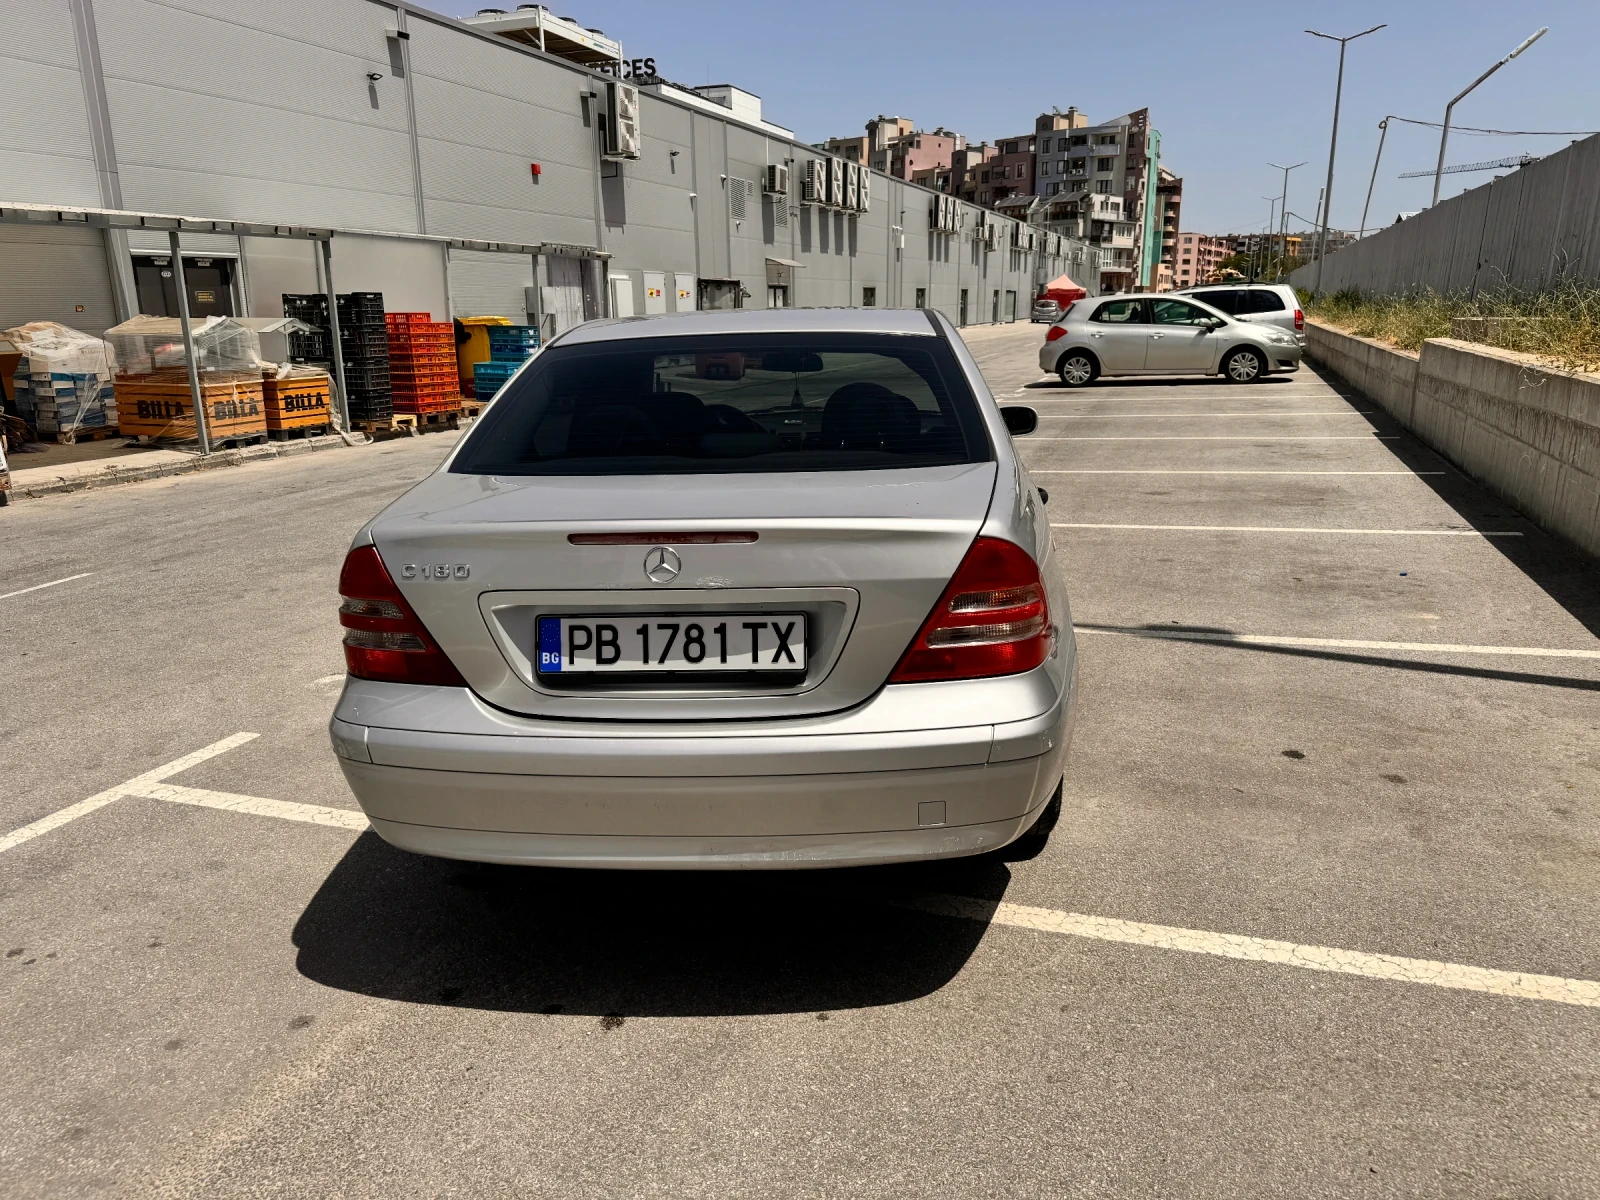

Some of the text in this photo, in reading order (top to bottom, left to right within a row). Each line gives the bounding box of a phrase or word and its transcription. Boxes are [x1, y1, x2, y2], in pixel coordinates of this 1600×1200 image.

[136, 400, 187, 420] BILLA
[213, 399, 260, 420] BILLA
[284, 391, 325, 412] BILLA
[401, 564, 470, 579] C 180
[568, 622, 796, 665] PB 1781 TX
[542, 652, 559, 664] BG
